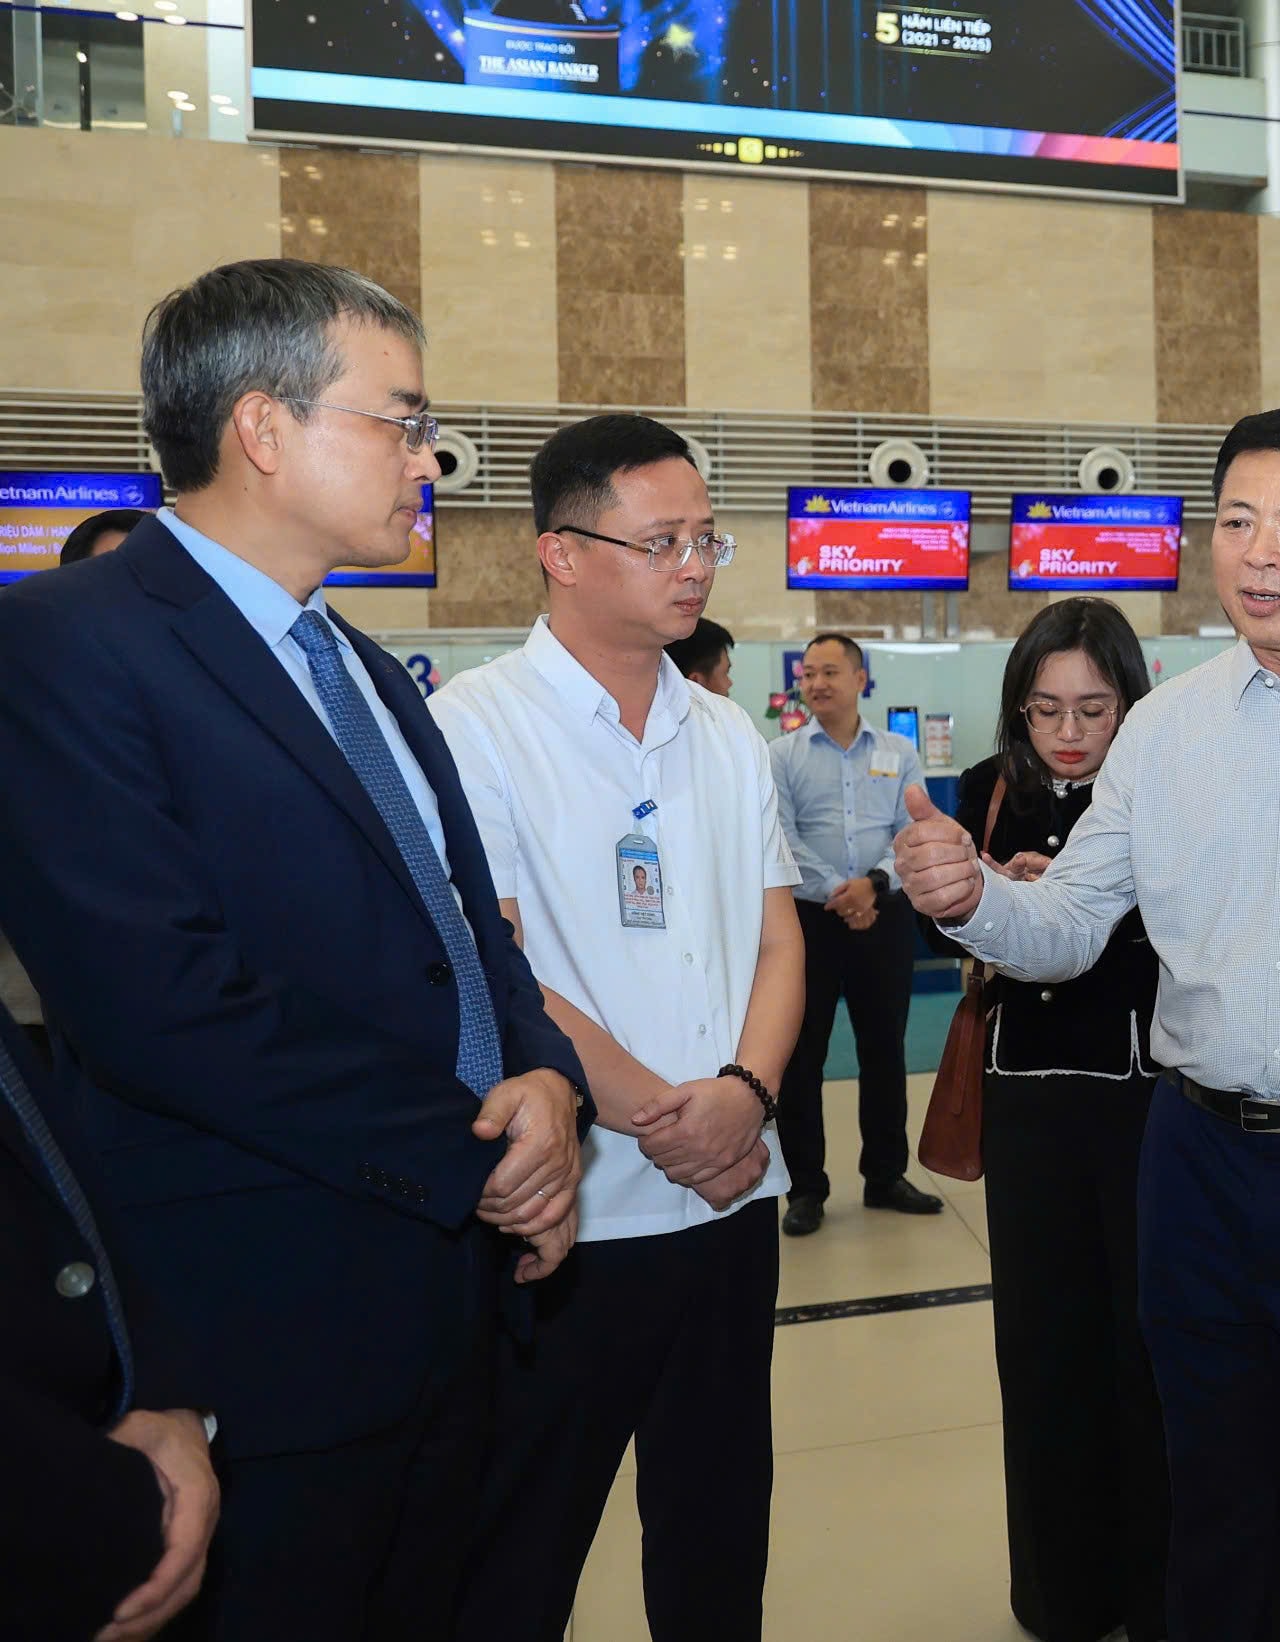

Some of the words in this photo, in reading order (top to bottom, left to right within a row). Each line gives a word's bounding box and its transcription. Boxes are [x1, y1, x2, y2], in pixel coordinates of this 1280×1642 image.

[876, 12, 900, 44] 5
[901, 14, 932, 30] NĂM
[901, 29, 938, 47] (2021
[820, 544, 857, 559] SKY
[1040, 548, 1075, 562] SKY
[819, 559, 904, 573] PRIORITY
[1039, 561, 1118, 575] PRIORITY
